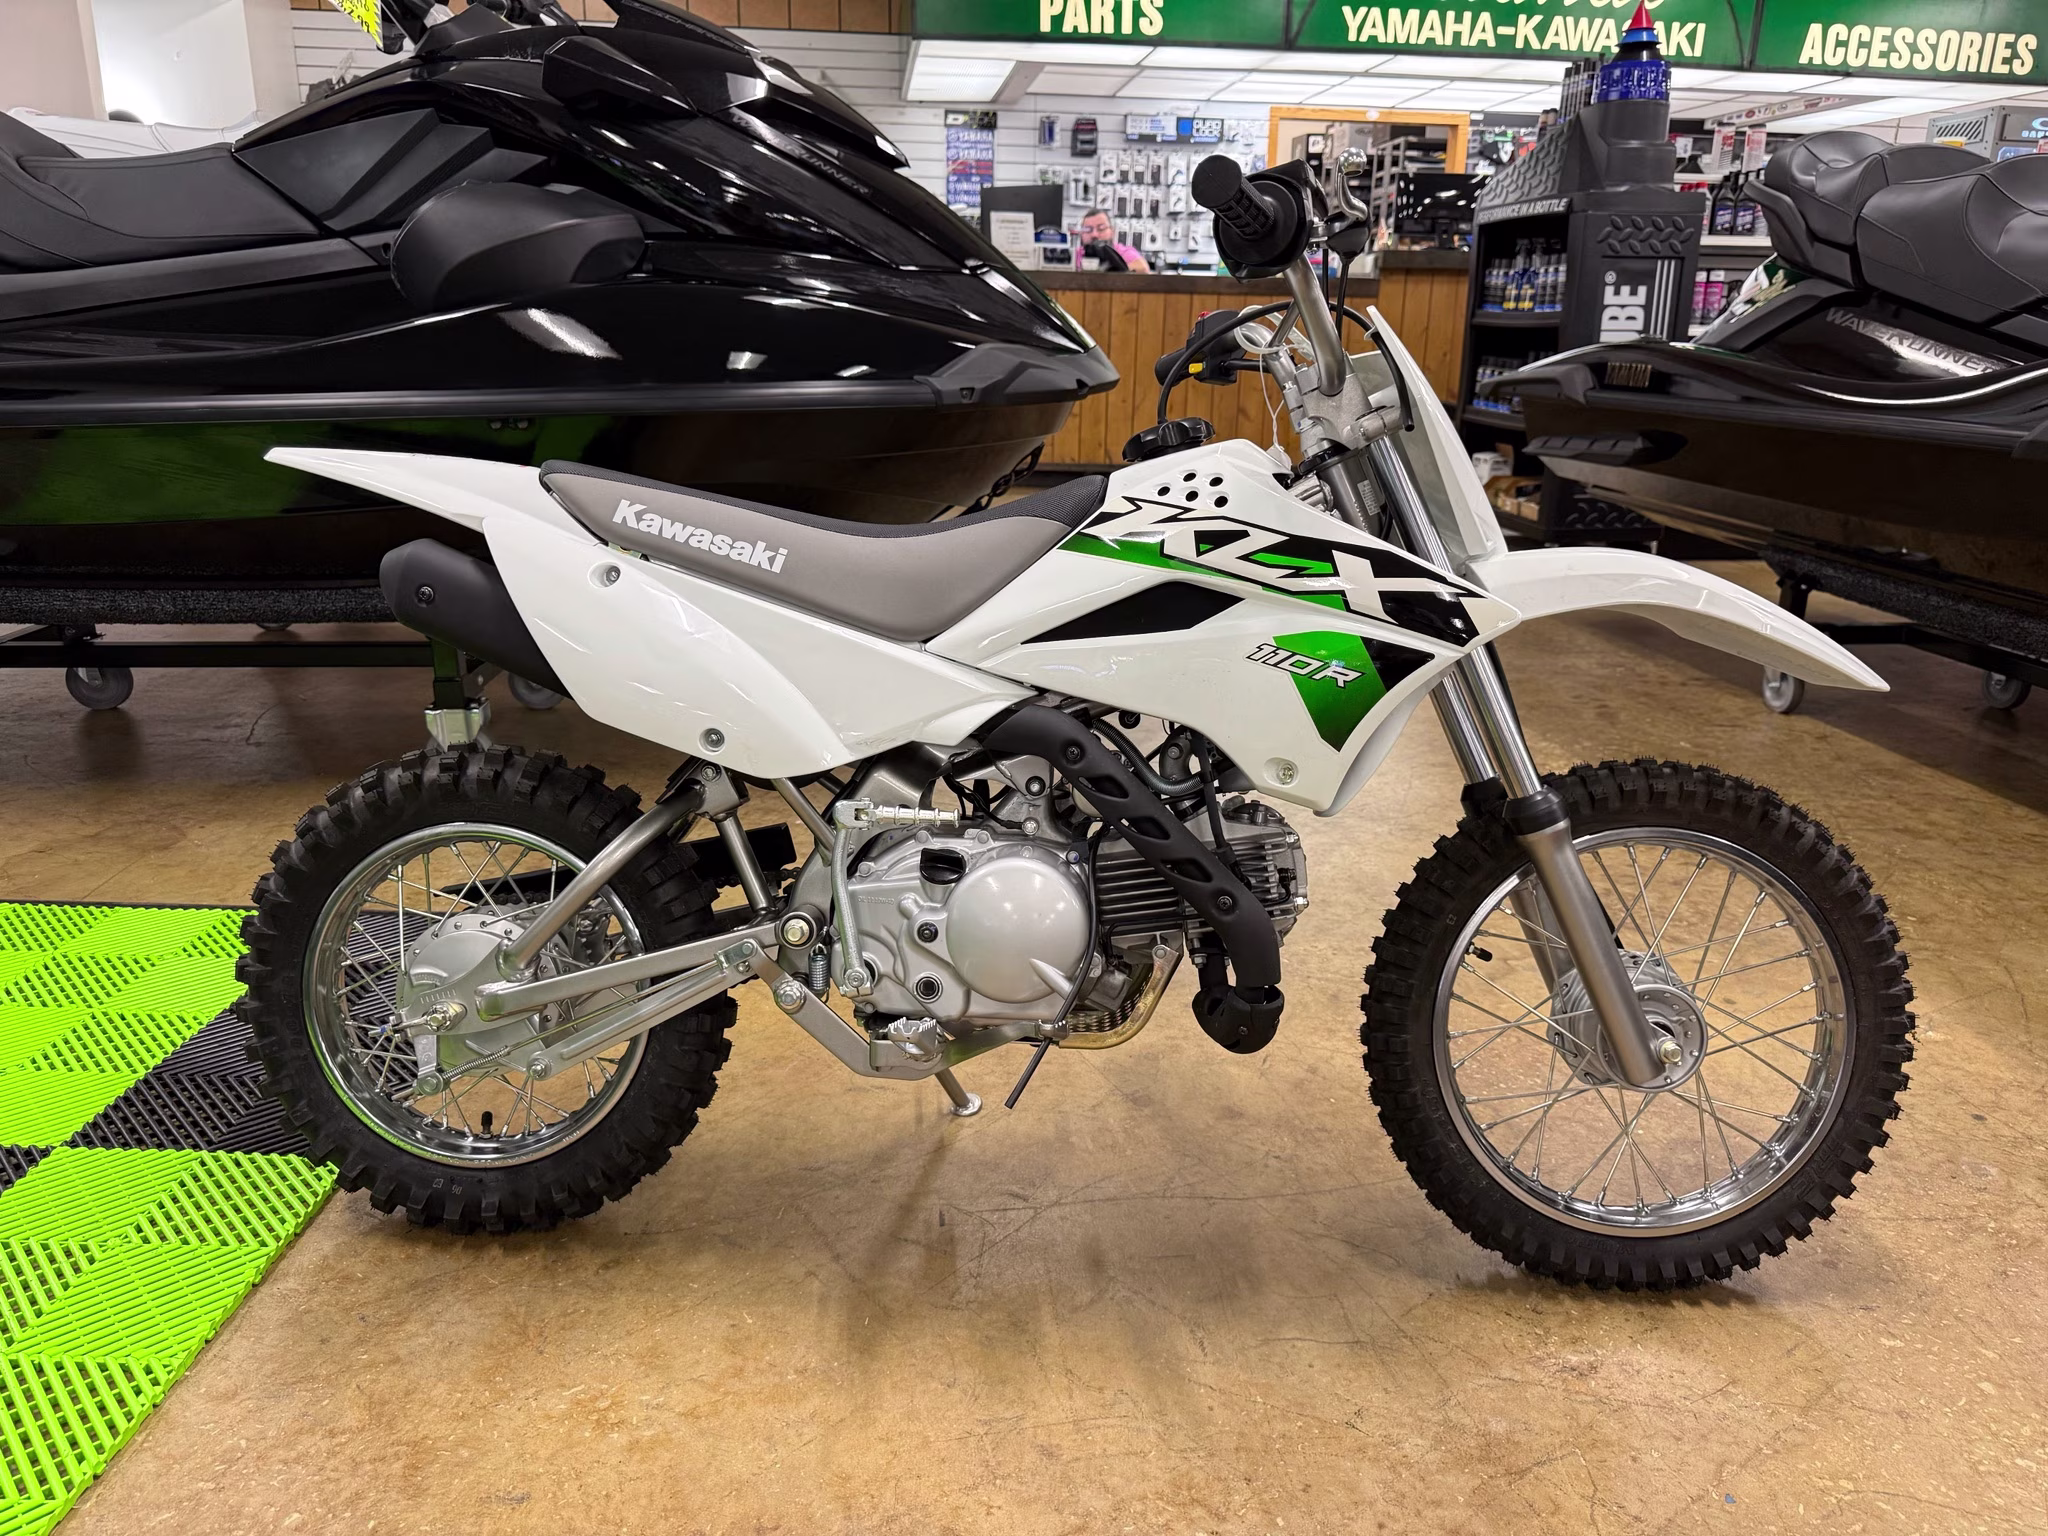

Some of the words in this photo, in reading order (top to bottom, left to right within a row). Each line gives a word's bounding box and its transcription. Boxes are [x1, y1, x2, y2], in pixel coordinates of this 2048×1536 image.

[1039, 0, 1164, 36] PARTS
[1341, 5, 1706, 57] YAMAHA-KAWAAKI
[1798, 22, 2038, 76] ACCESSORIES
[731, 113, 869, 195] WAERUNNER
[612, 499, 788, 574] Kawasaki
[1245, 642, 1366, 689] 110R
